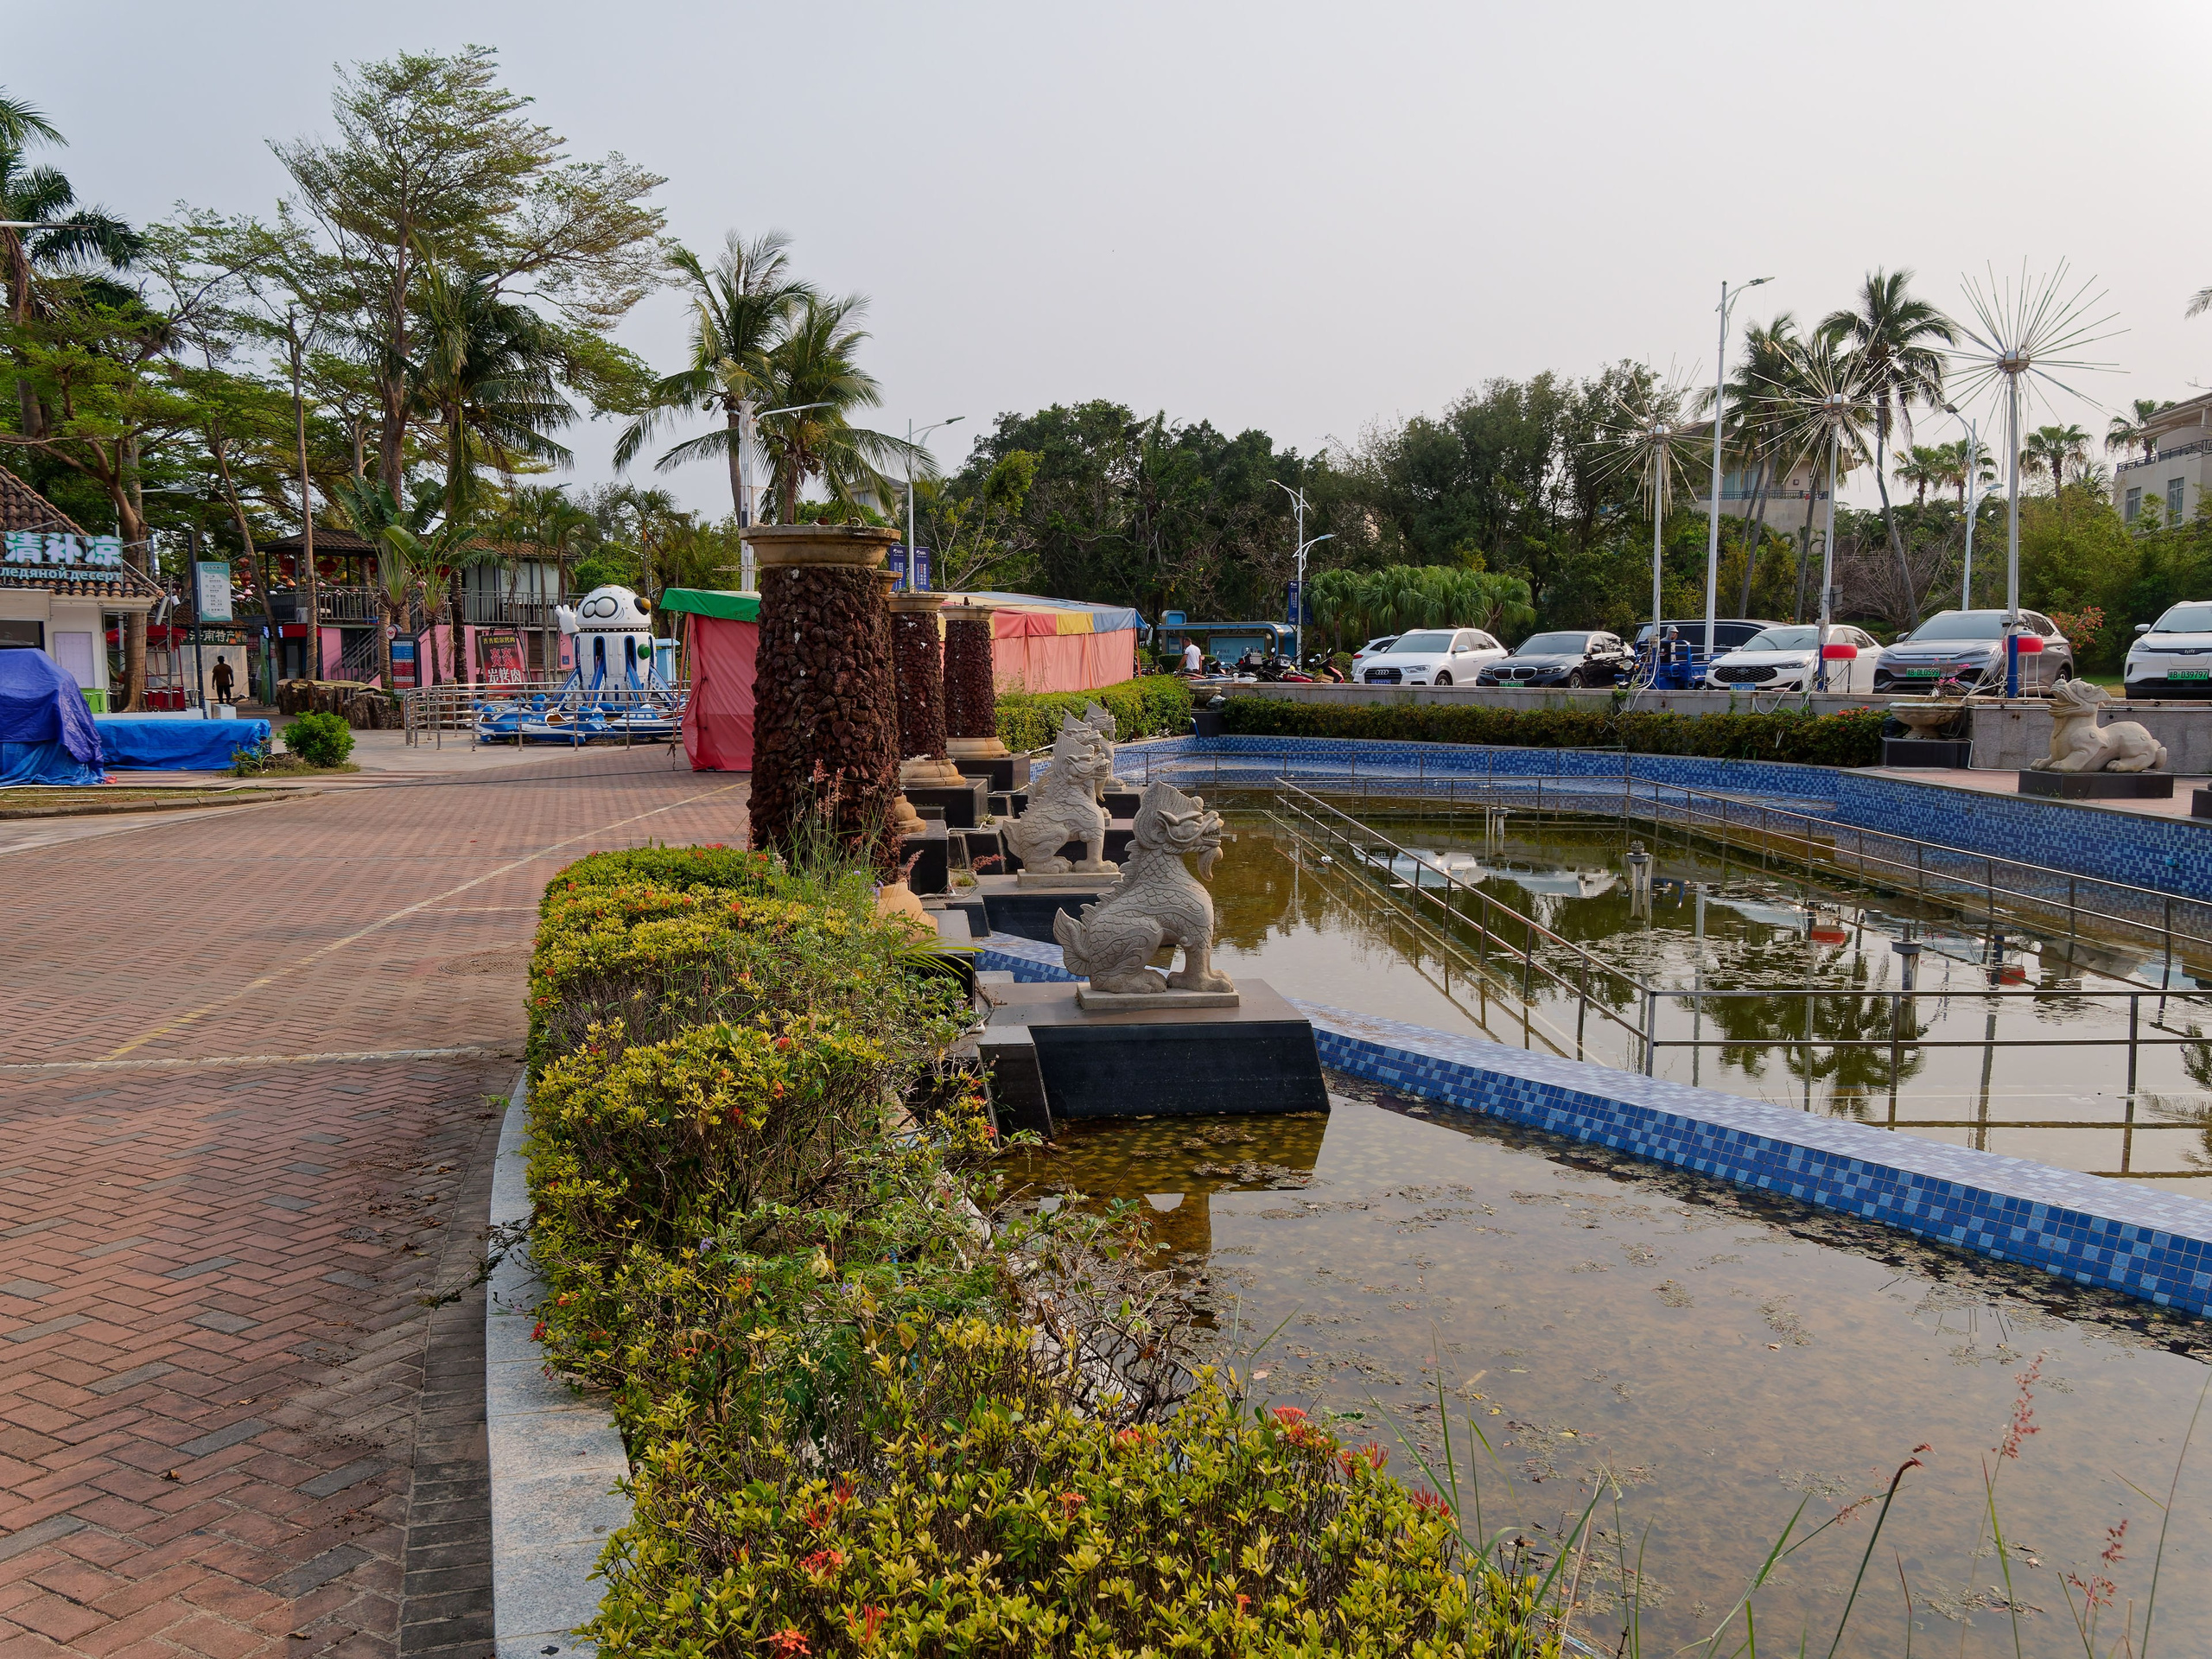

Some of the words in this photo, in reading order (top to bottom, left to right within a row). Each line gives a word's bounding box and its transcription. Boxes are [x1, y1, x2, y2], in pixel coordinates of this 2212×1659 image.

[3, 531, 123, 566] 清补凉
[0, 566, 67, 580] ледяной
[69, 570, 121, 583] десерт
[487, 667, 522, 683] 炭烤肉
